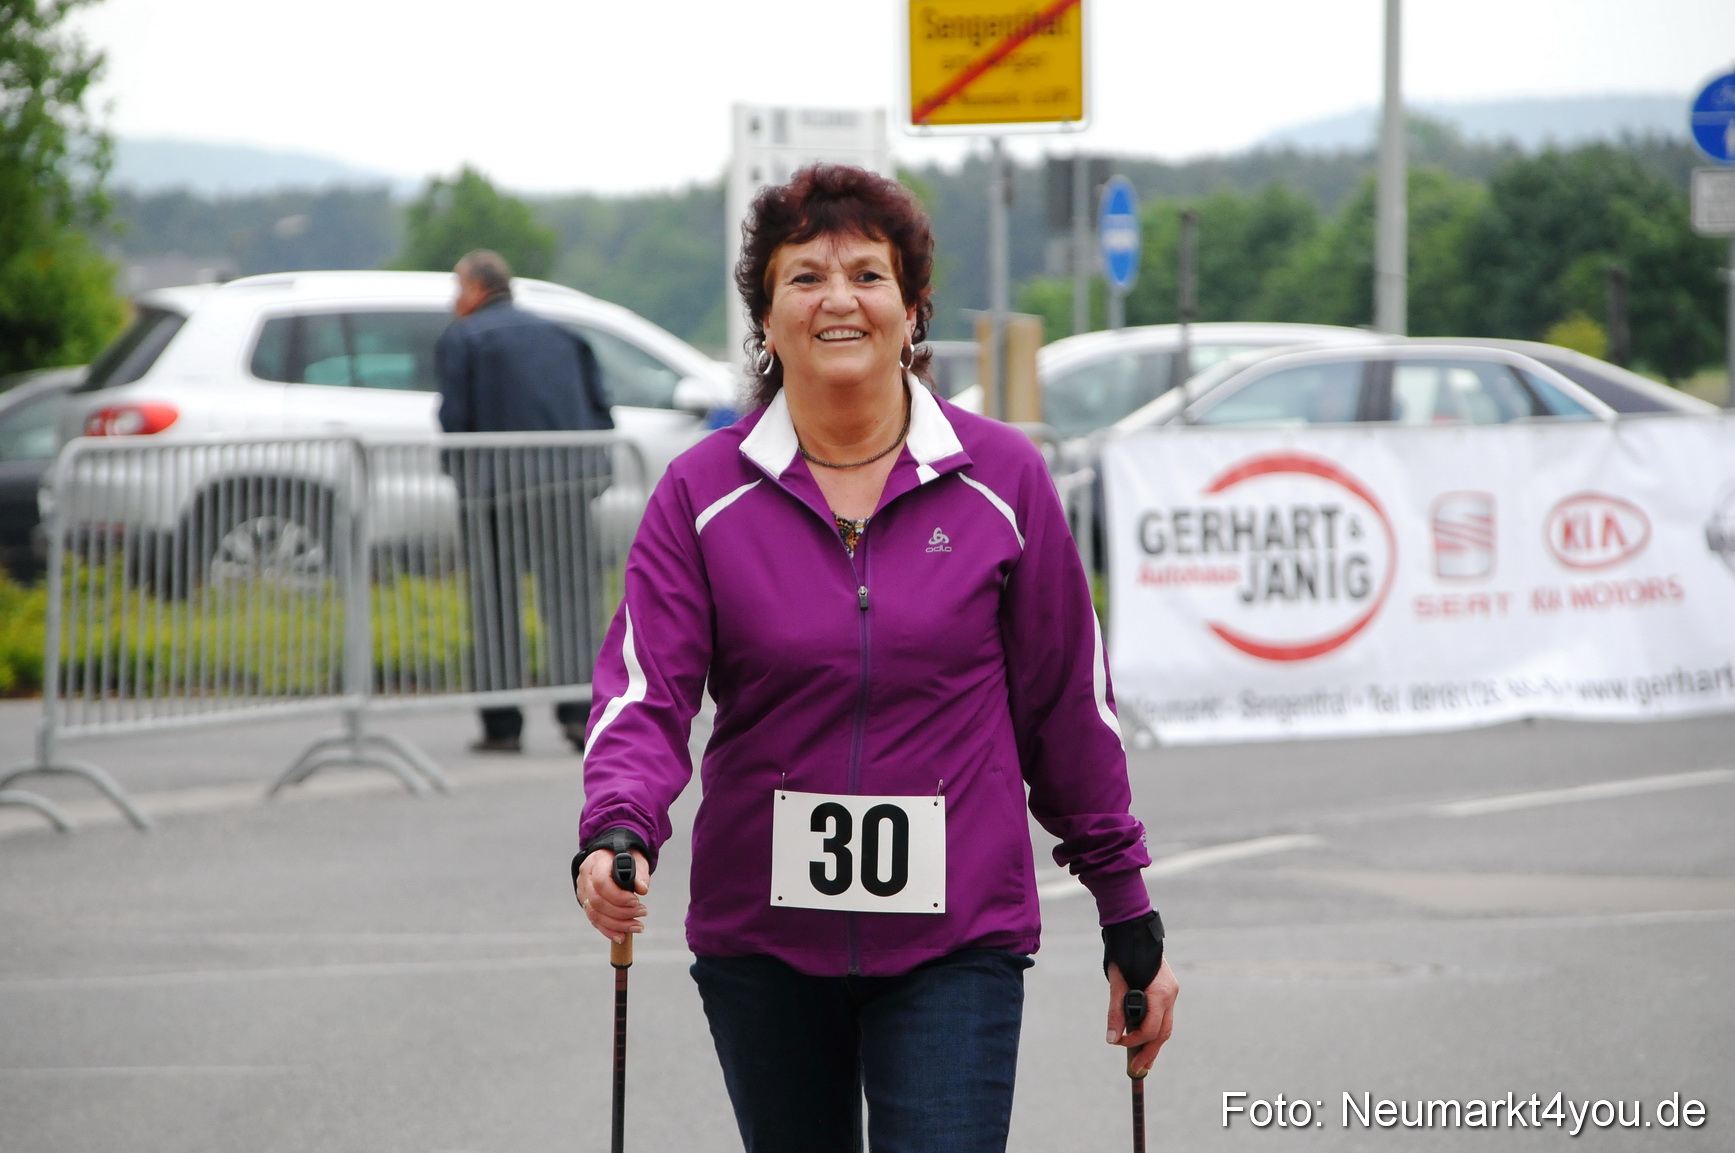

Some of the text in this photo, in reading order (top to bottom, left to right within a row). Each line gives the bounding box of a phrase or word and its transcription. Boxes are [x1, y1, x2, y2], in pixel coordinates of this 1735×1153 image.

[925, 545, 952, 553] odlo
[1138, 504, 1343, 555] GERHART
[1561, 508, 1628, 549] KIA
[1238, 553, 1372, 605] JANIG
[1569, 573, 1687, 612] MOTORS
[1414, 592, 1513, 619] SEAT
[809, 802, 909, 897] 30
